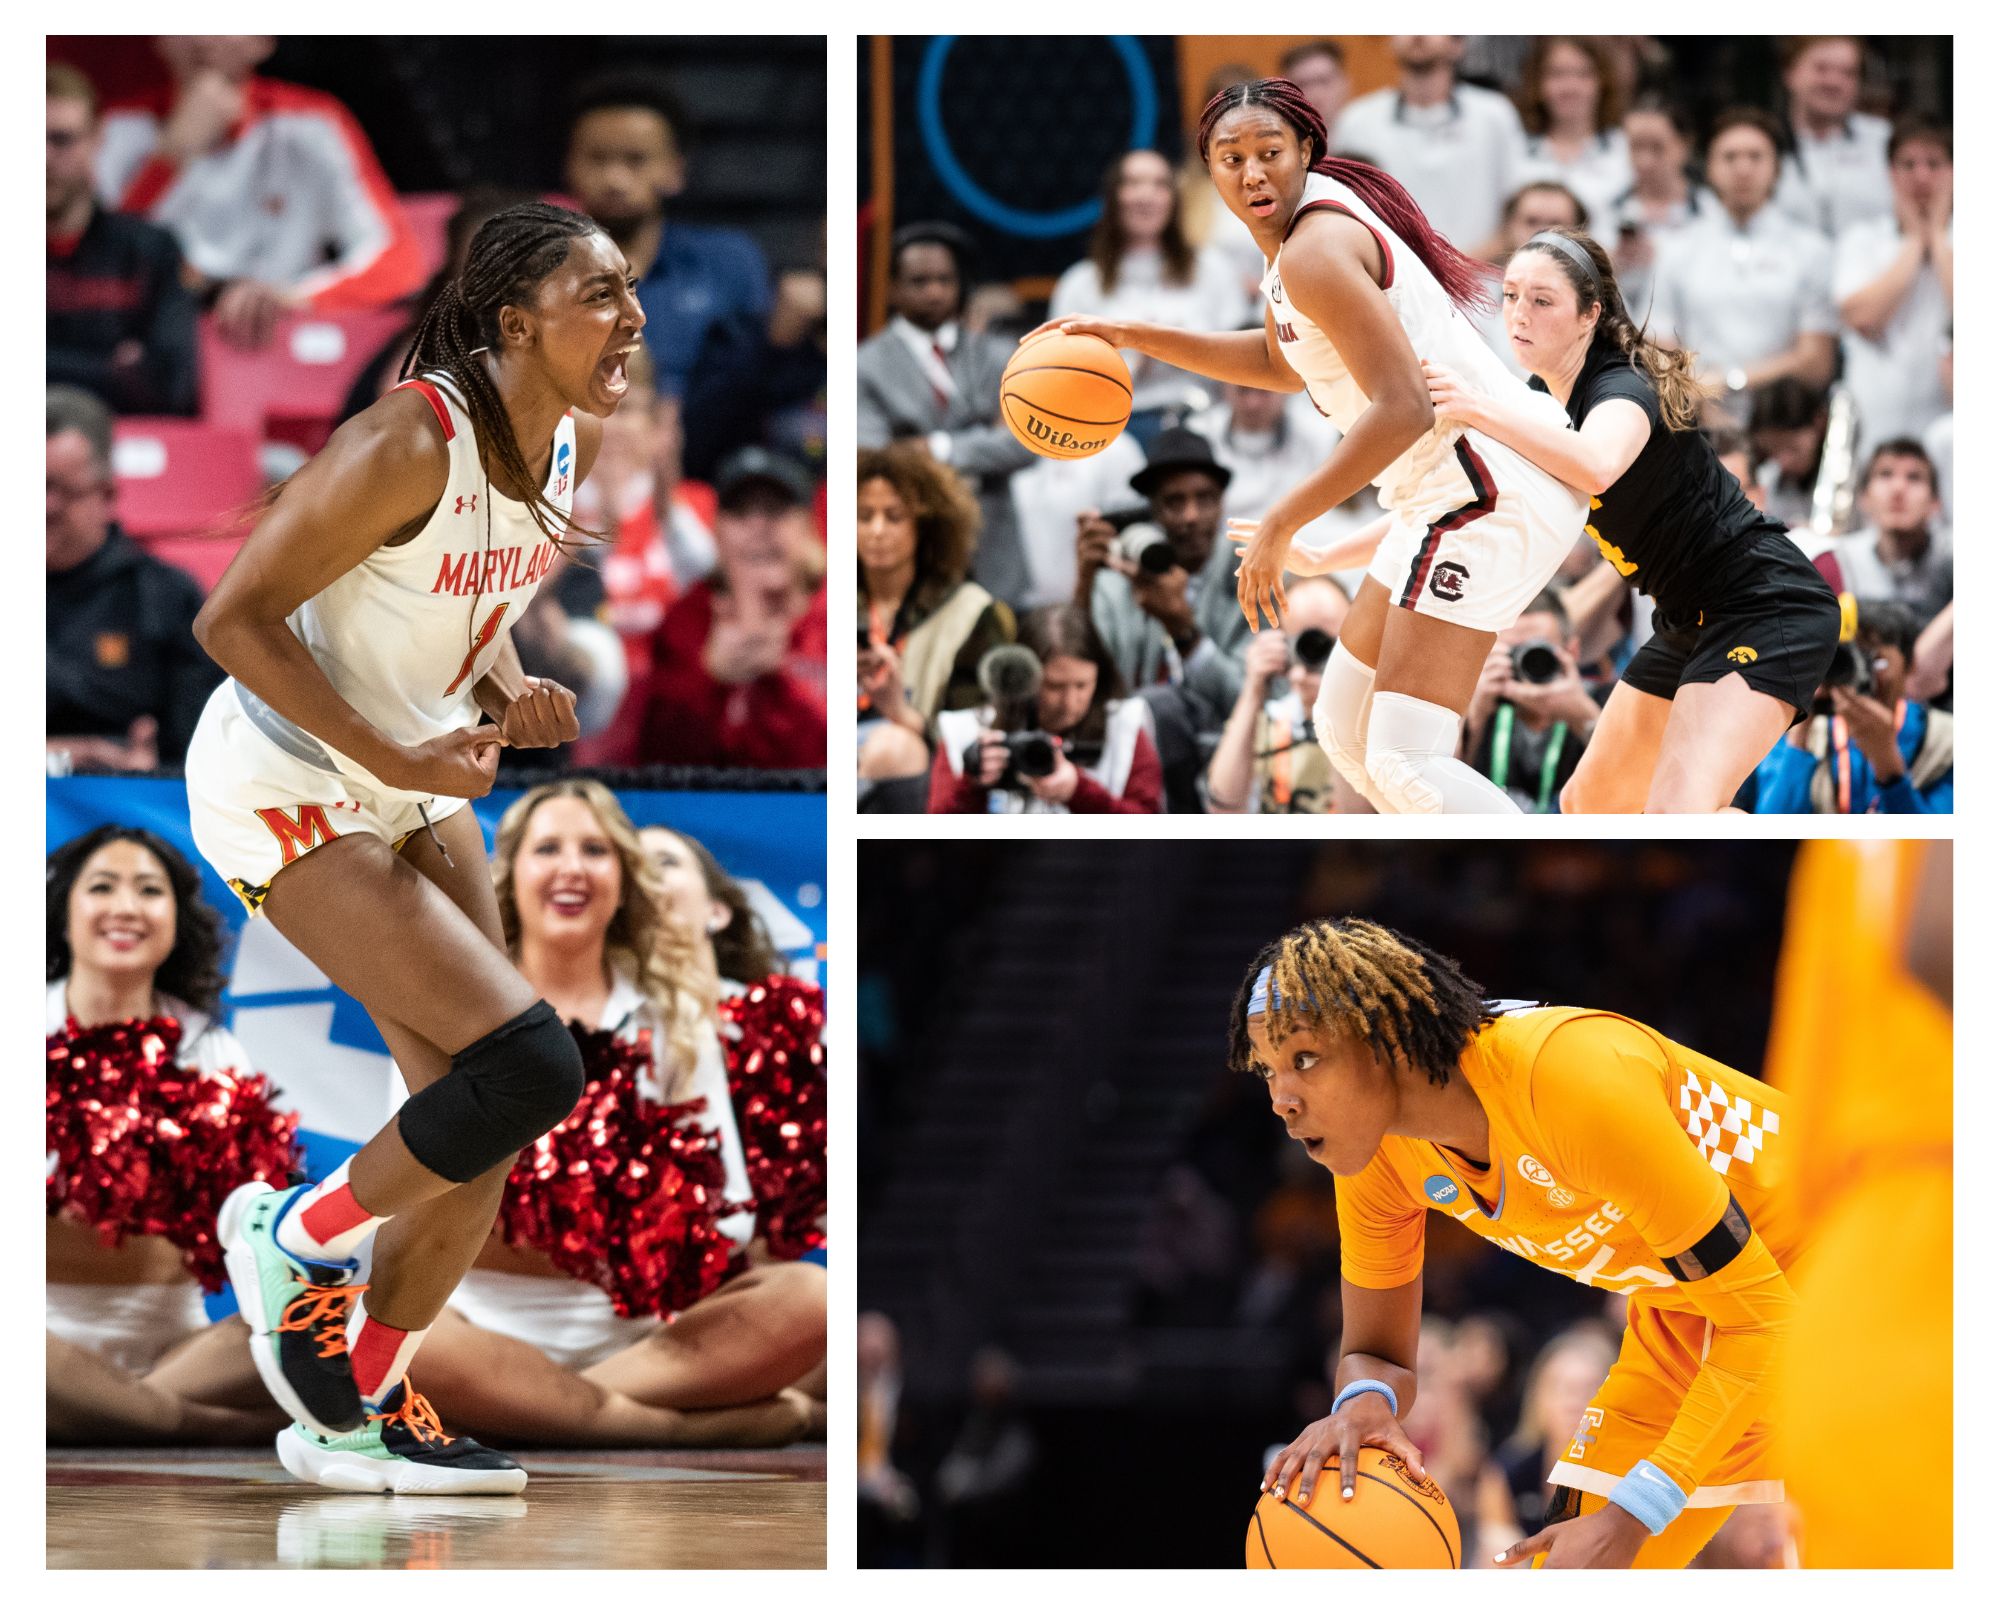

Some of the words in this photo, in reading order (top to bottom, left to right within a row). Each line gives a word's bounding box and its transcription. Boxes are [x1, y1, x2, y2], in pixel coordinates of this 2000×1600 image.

[1027, 414, 1107, 450] Wilson
[431, 533, 560, 596] MARYLAND
[442, 602, 510, 698] 1
[254, 804, 341, 866] M
[1432, 1184, 1458, 1201] NCAA
